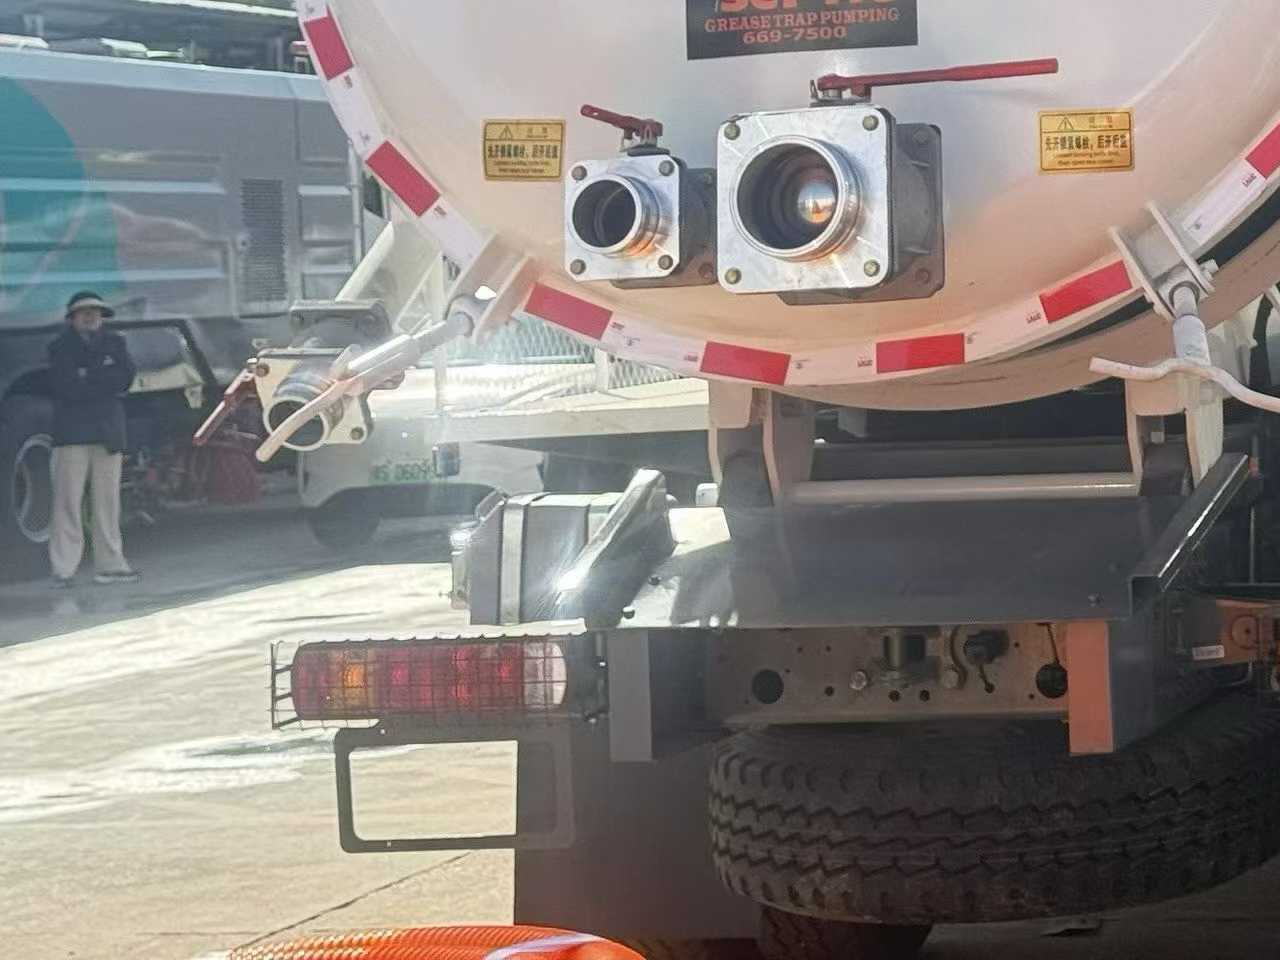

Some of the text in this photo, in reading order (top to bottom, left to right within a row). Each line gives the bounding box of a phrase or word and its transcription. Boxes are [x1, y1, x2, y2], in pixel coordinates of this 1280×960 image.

[704, 7, 900, 33] GREASE TRAP PUMPING
[743, 26, 848, 44] 669-7500
